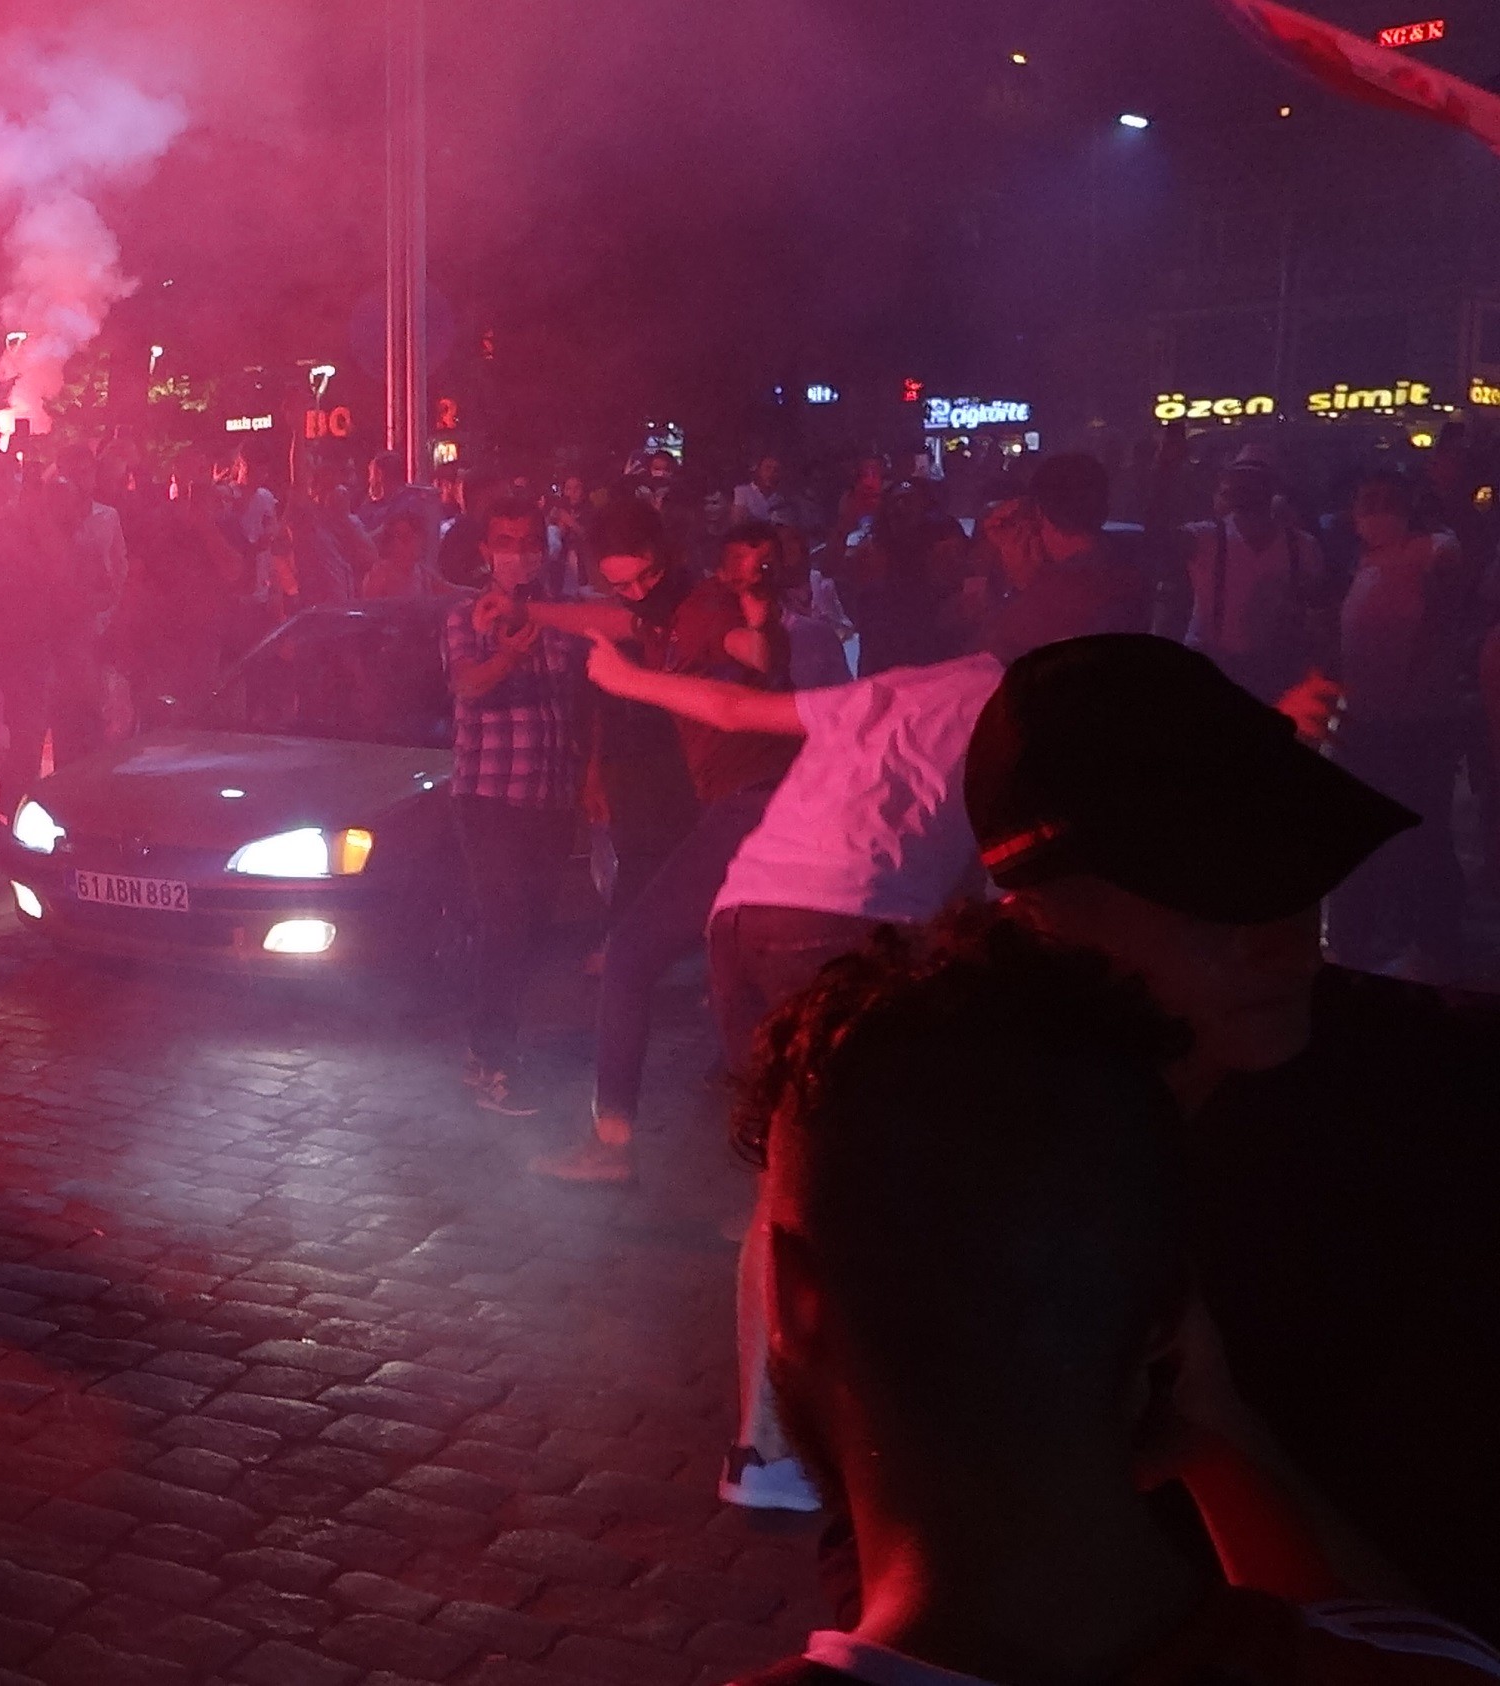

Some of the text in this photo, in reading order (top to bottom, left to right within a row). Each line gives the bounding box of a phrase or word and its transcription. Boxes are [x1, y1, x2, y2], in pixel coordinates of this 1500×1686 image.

[1155, 381, 1430, 419] özen simit
[78, 874, 99, 899] 61
[106, 877, 142, 904] ABN
